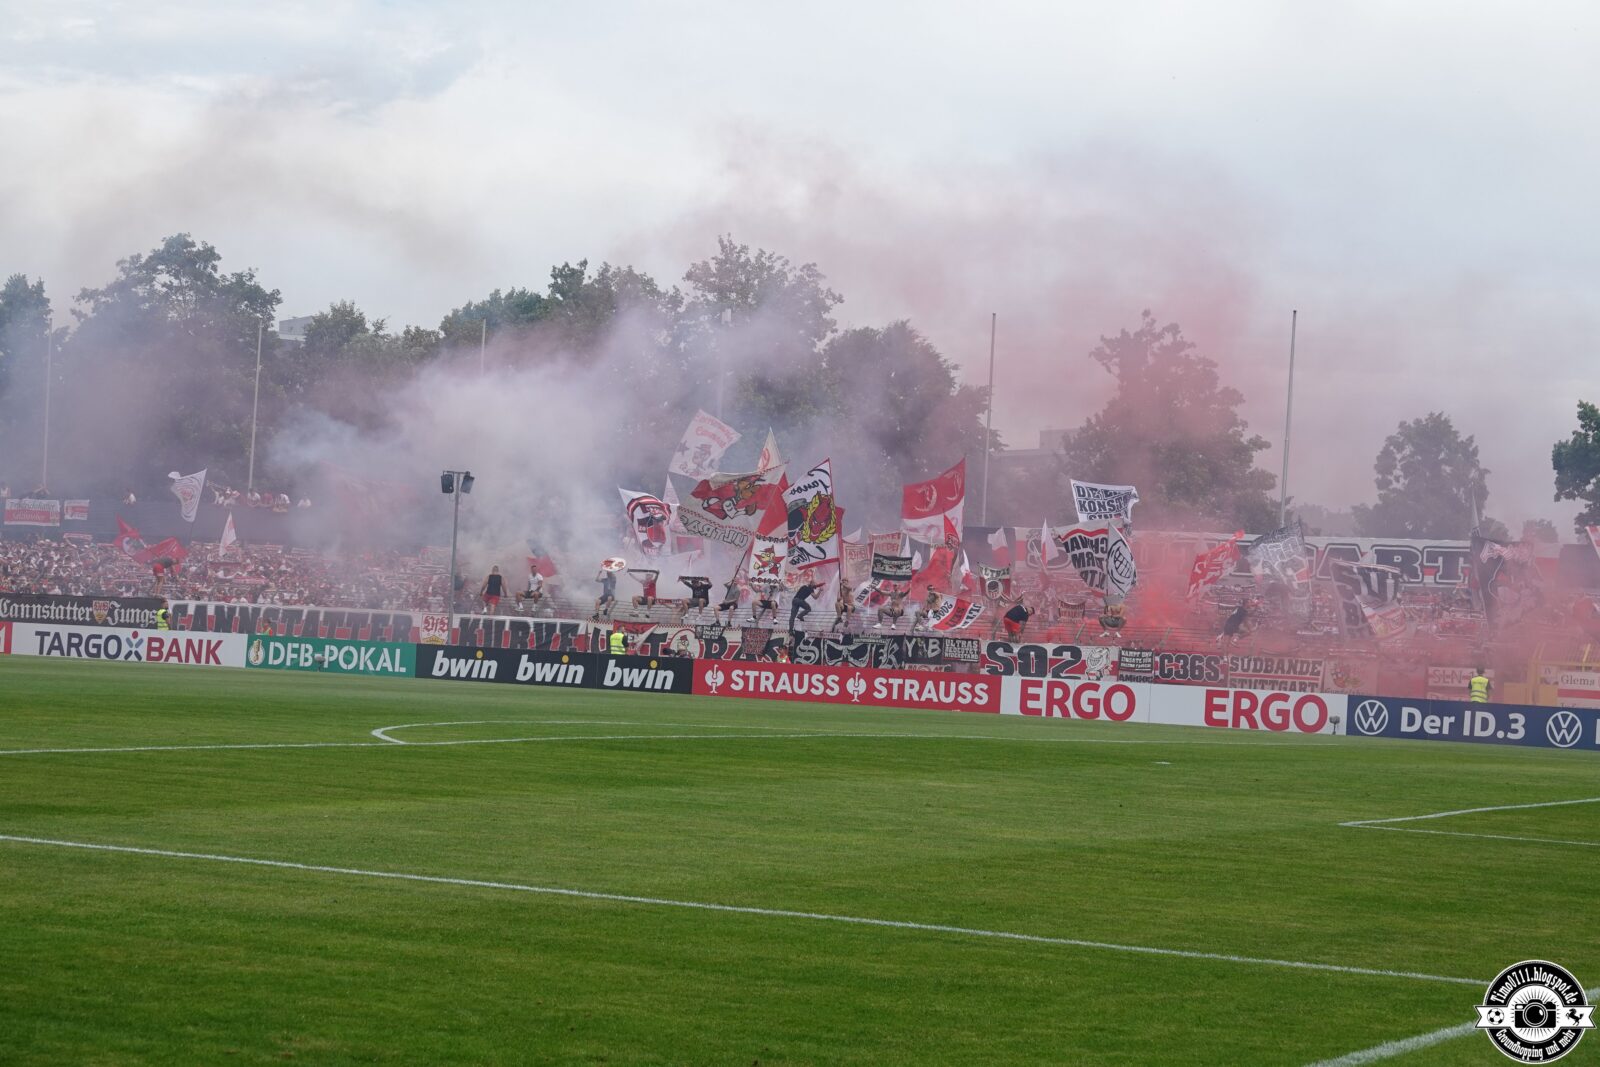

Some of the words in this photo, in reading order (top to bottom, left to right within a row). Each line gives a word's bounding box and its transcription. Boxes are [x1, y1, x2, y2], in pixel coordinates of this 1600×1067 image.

[0, 598, 93, 622] Cannstatter
[107, 602, 158, 628] Jungs
[268, 641, 407, 673] DFB-POKAL
[945, 639, 978, 649] ULTRAS
[431, 650, 498, 679] bwin
[516, 654, 584, 684] bwin
[603, 658, 675, 690] bwin
[730, 669, 840, 697] STRAUSS
[873, 677, 989, 705] STRAUSS
[1019, 679, 1136, 721] ERGO
[1204, 689, 1328, 733] ERGO
[1400, 706, 1455, 735] Der
[1463, 710, 1526, 740] ID.3
